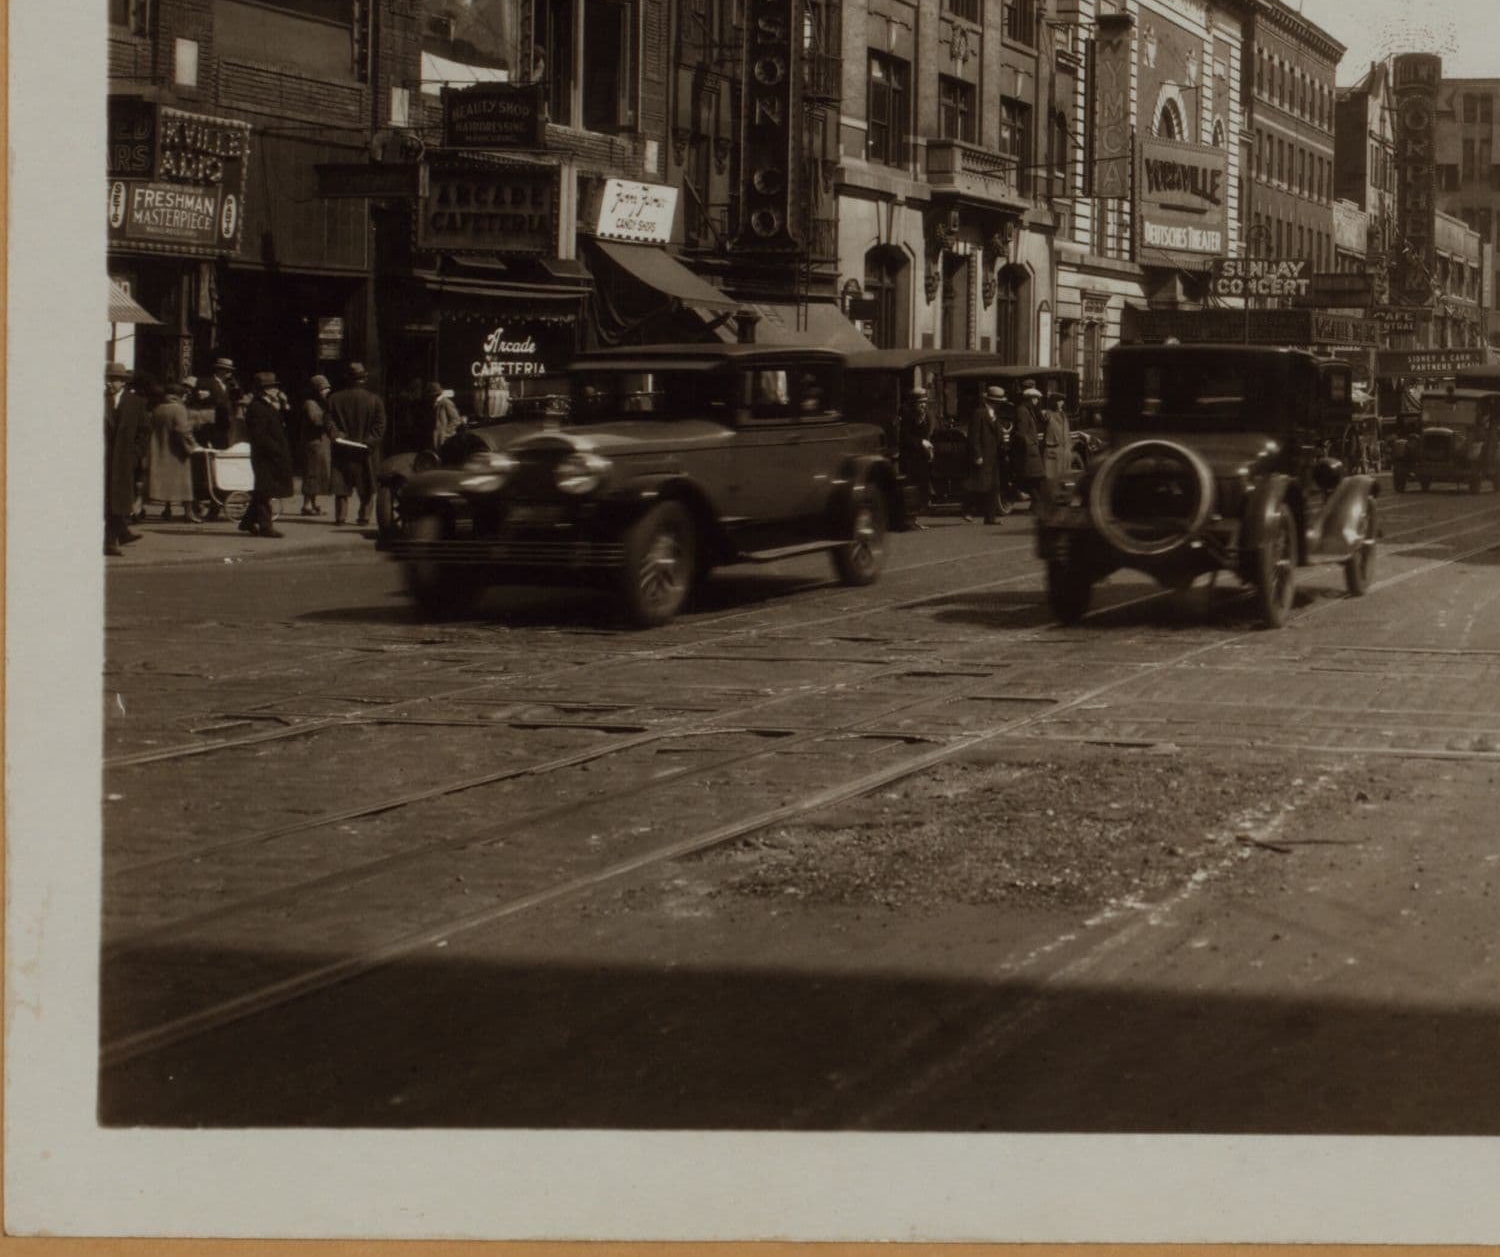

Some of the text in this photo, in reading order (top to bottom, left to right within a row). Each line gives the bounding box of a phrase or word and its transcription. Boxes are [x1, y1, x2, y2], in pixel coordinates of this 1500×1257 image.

[132, 188, 215, 218] FRESHMAN
[750, 164, 783, 238] CO
[131, 207, 214, 231] MASTERPIECE
[483, 327, 537, 354] Arcade
[471, 361, 546, 377] CAFETERIA
